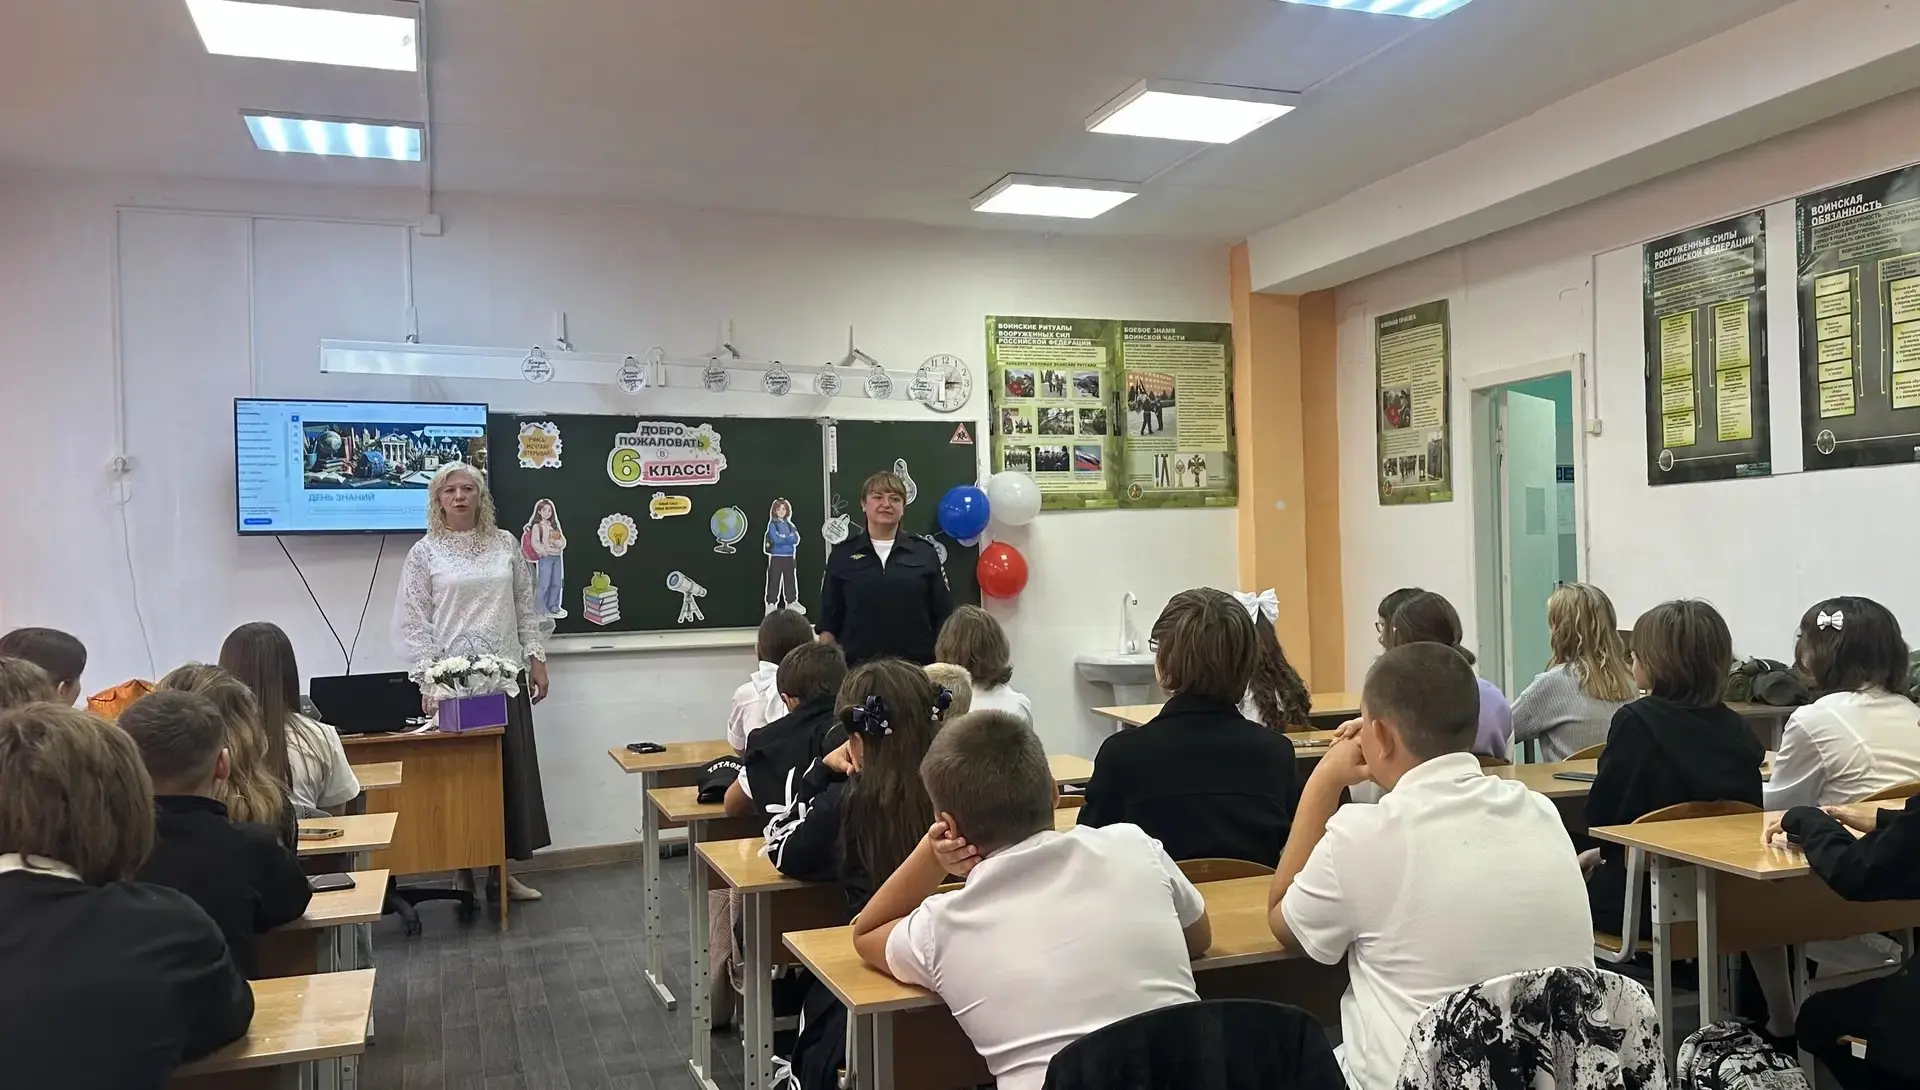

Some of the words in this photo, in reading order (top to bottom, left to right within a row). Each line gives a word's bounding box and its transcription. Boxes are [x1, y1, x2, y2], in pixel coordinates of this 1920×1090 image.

[1811, 193, 1863, 216] ВОИНСКАЯ
[1811, 200, 1882, 226] ОБЯЗАННОСТЬ
[1654, 237, 1711, 261] ВООРУЖЕННЫЕ
[1712, 230, 1737, 243] СИЛЫ
[1654, 248, 1702, 269] РОССИЙСКОЙ
[1703, 235, 1754, 255] ФЕДЕРАЦИИ
[998, 338, 1047, 346] РОССИЙСКОЙ
[942, 356, 950, 364] 12
[962, 368, 967, 376] 2
[964, 379, 970, 387] 3
[641, 425, 683, 436] ДОБРО
[619, 437, 704, 448] ПОЖАЛОВАТЬ
[611, 448, 642, 482] 6
[649, 464, 711, 476] КЛАСС!
[308, 494, 334, 503] ДЕНЬ
[335, 493, 376, 502] ЗНАНИЙ
